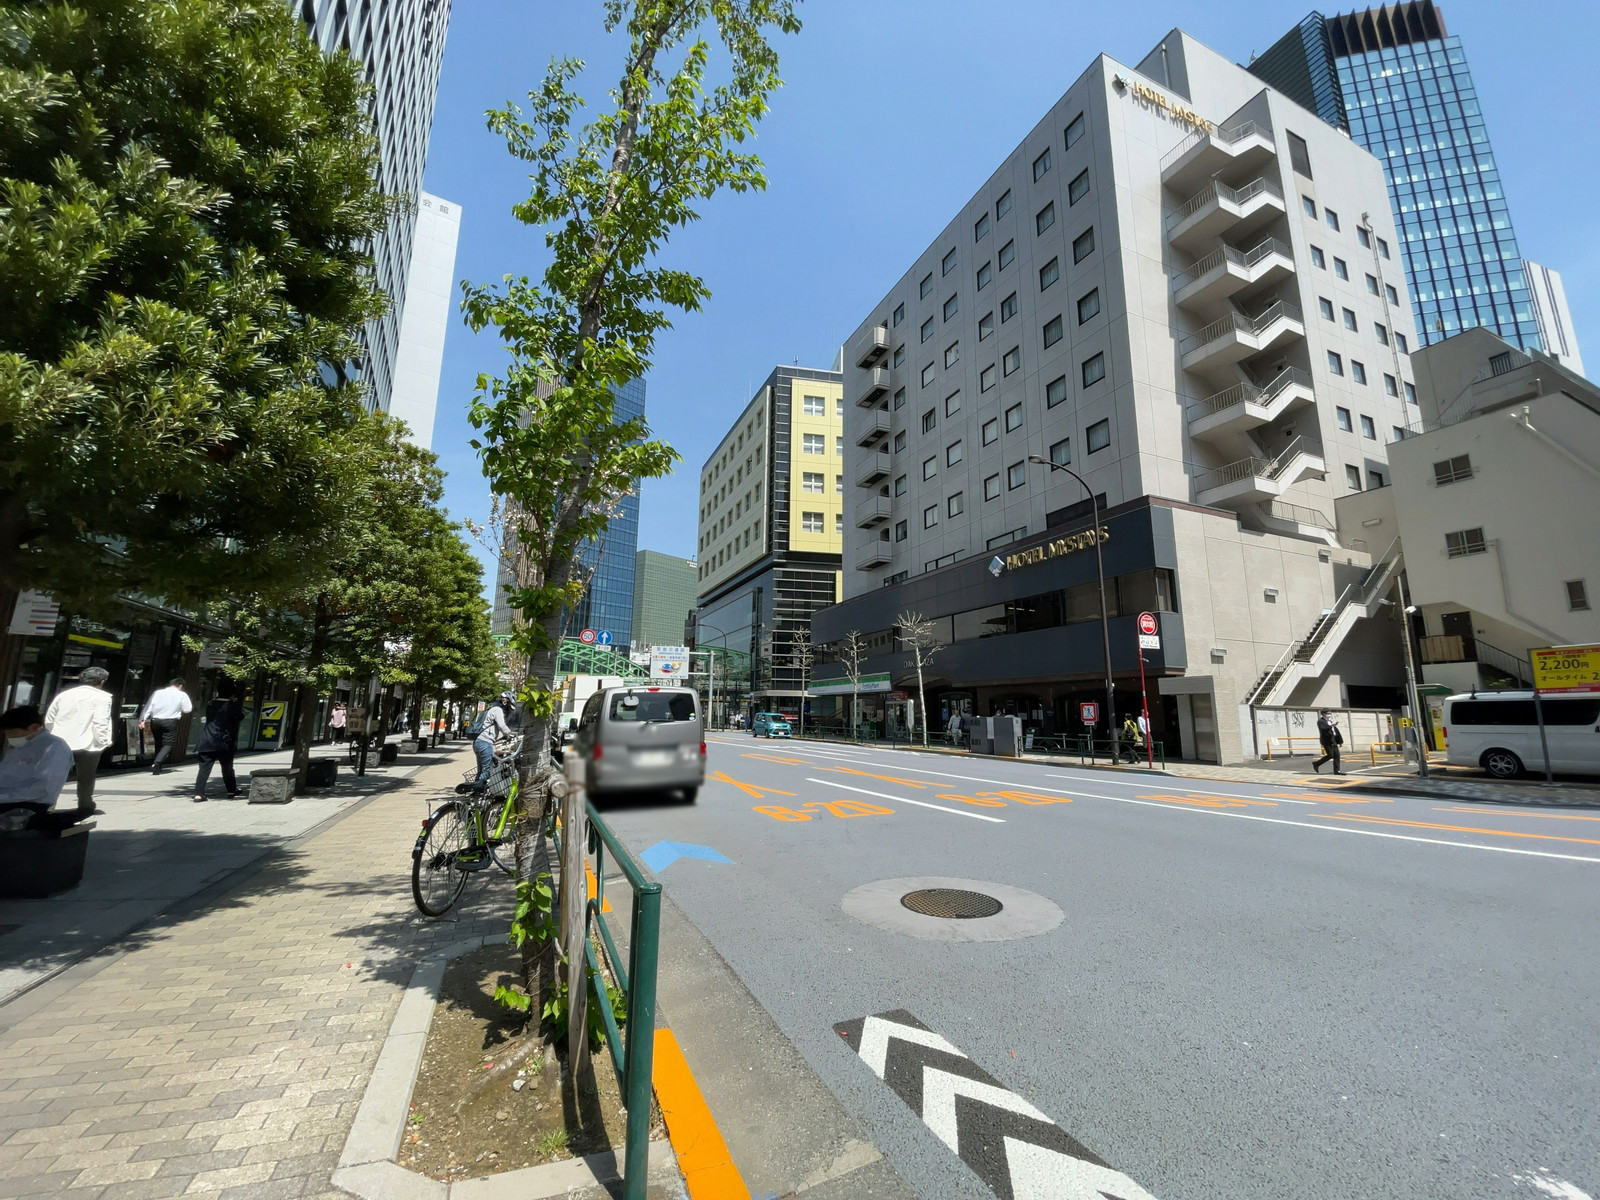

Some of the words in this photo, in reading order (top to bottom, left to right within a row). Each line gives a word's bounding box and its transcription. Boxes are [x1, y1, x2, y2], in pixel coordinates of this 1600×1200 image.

[1133, 81, 1169, 111] HOTEL
[422, 198, 449, 214] 会館
[1006, 546, 1047, 571] HOTEL
[1049, 525, 1110, 558] MYSTAYS
[904, 660, 915, 669] OAK
[1539, 659, 1590, 671] 2,200円
[935, 790, 1073, 808] 8-20
[752, 799, 896, 822] 8-20
